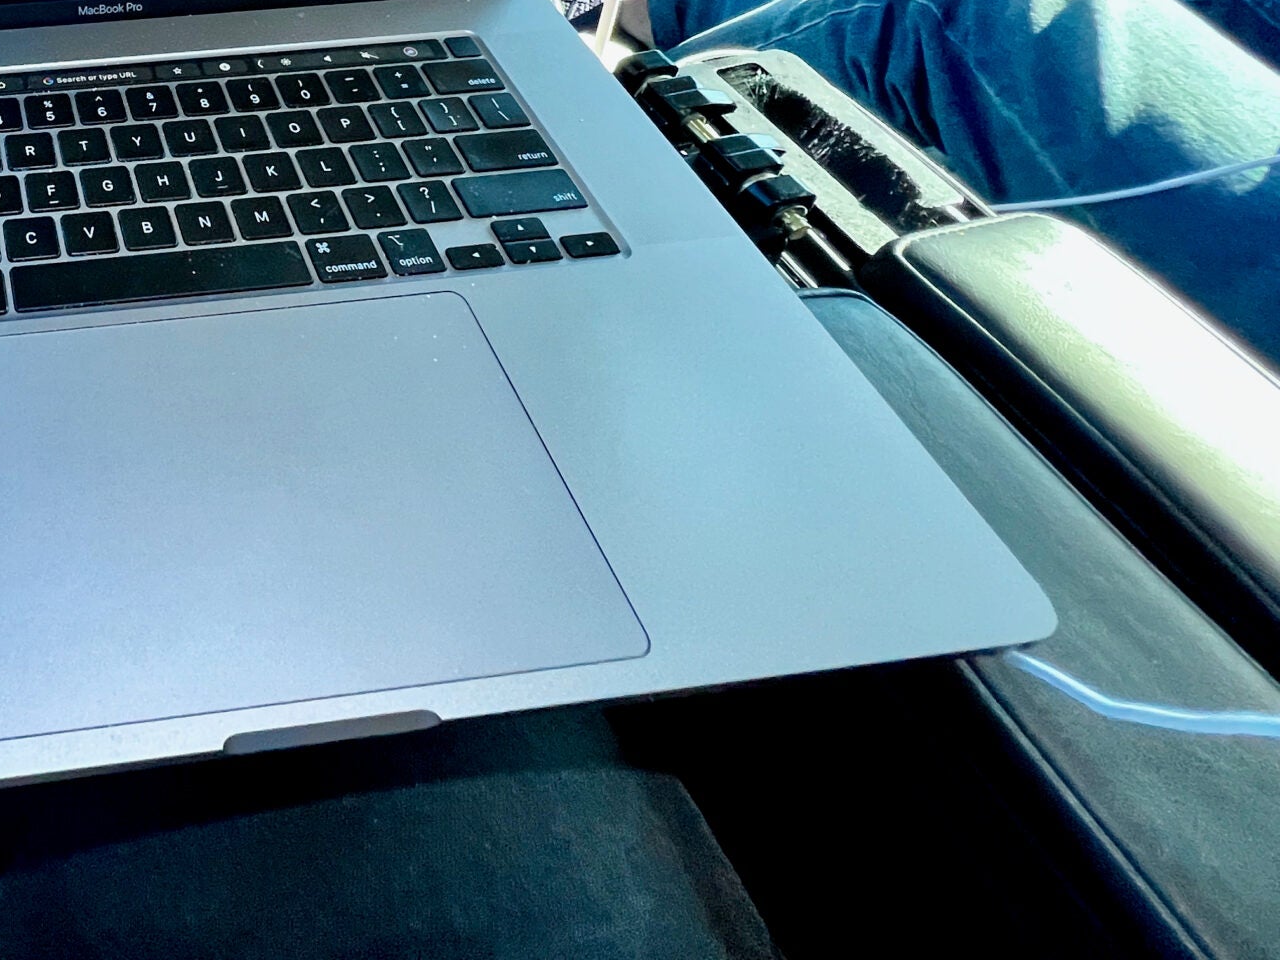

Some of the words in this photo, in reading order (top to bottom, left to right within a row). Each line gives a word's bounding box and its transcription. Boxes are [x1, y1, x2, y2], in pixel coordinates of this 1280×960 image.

[78, 3, 124, 16] MacBook
[126, 2, 143, 12] Pro
[56, 76, 87, 84] Search
[98, 73, 118, 81] type
[118, 71, 137, 79] URL
[467, 77, 496, 86] delete
[517, 150, 548, 160] return
[553, 191, 578, 203] shift
[198, 216, 212, 228] N
[254, 210, 270, 224] M
[83, 226, 95, 239] V
[141, 221, 154, 234] B
[25, 232, 38, 245] C
[325, 259, 378, 273] command
[399, 254, 433, 268] option
